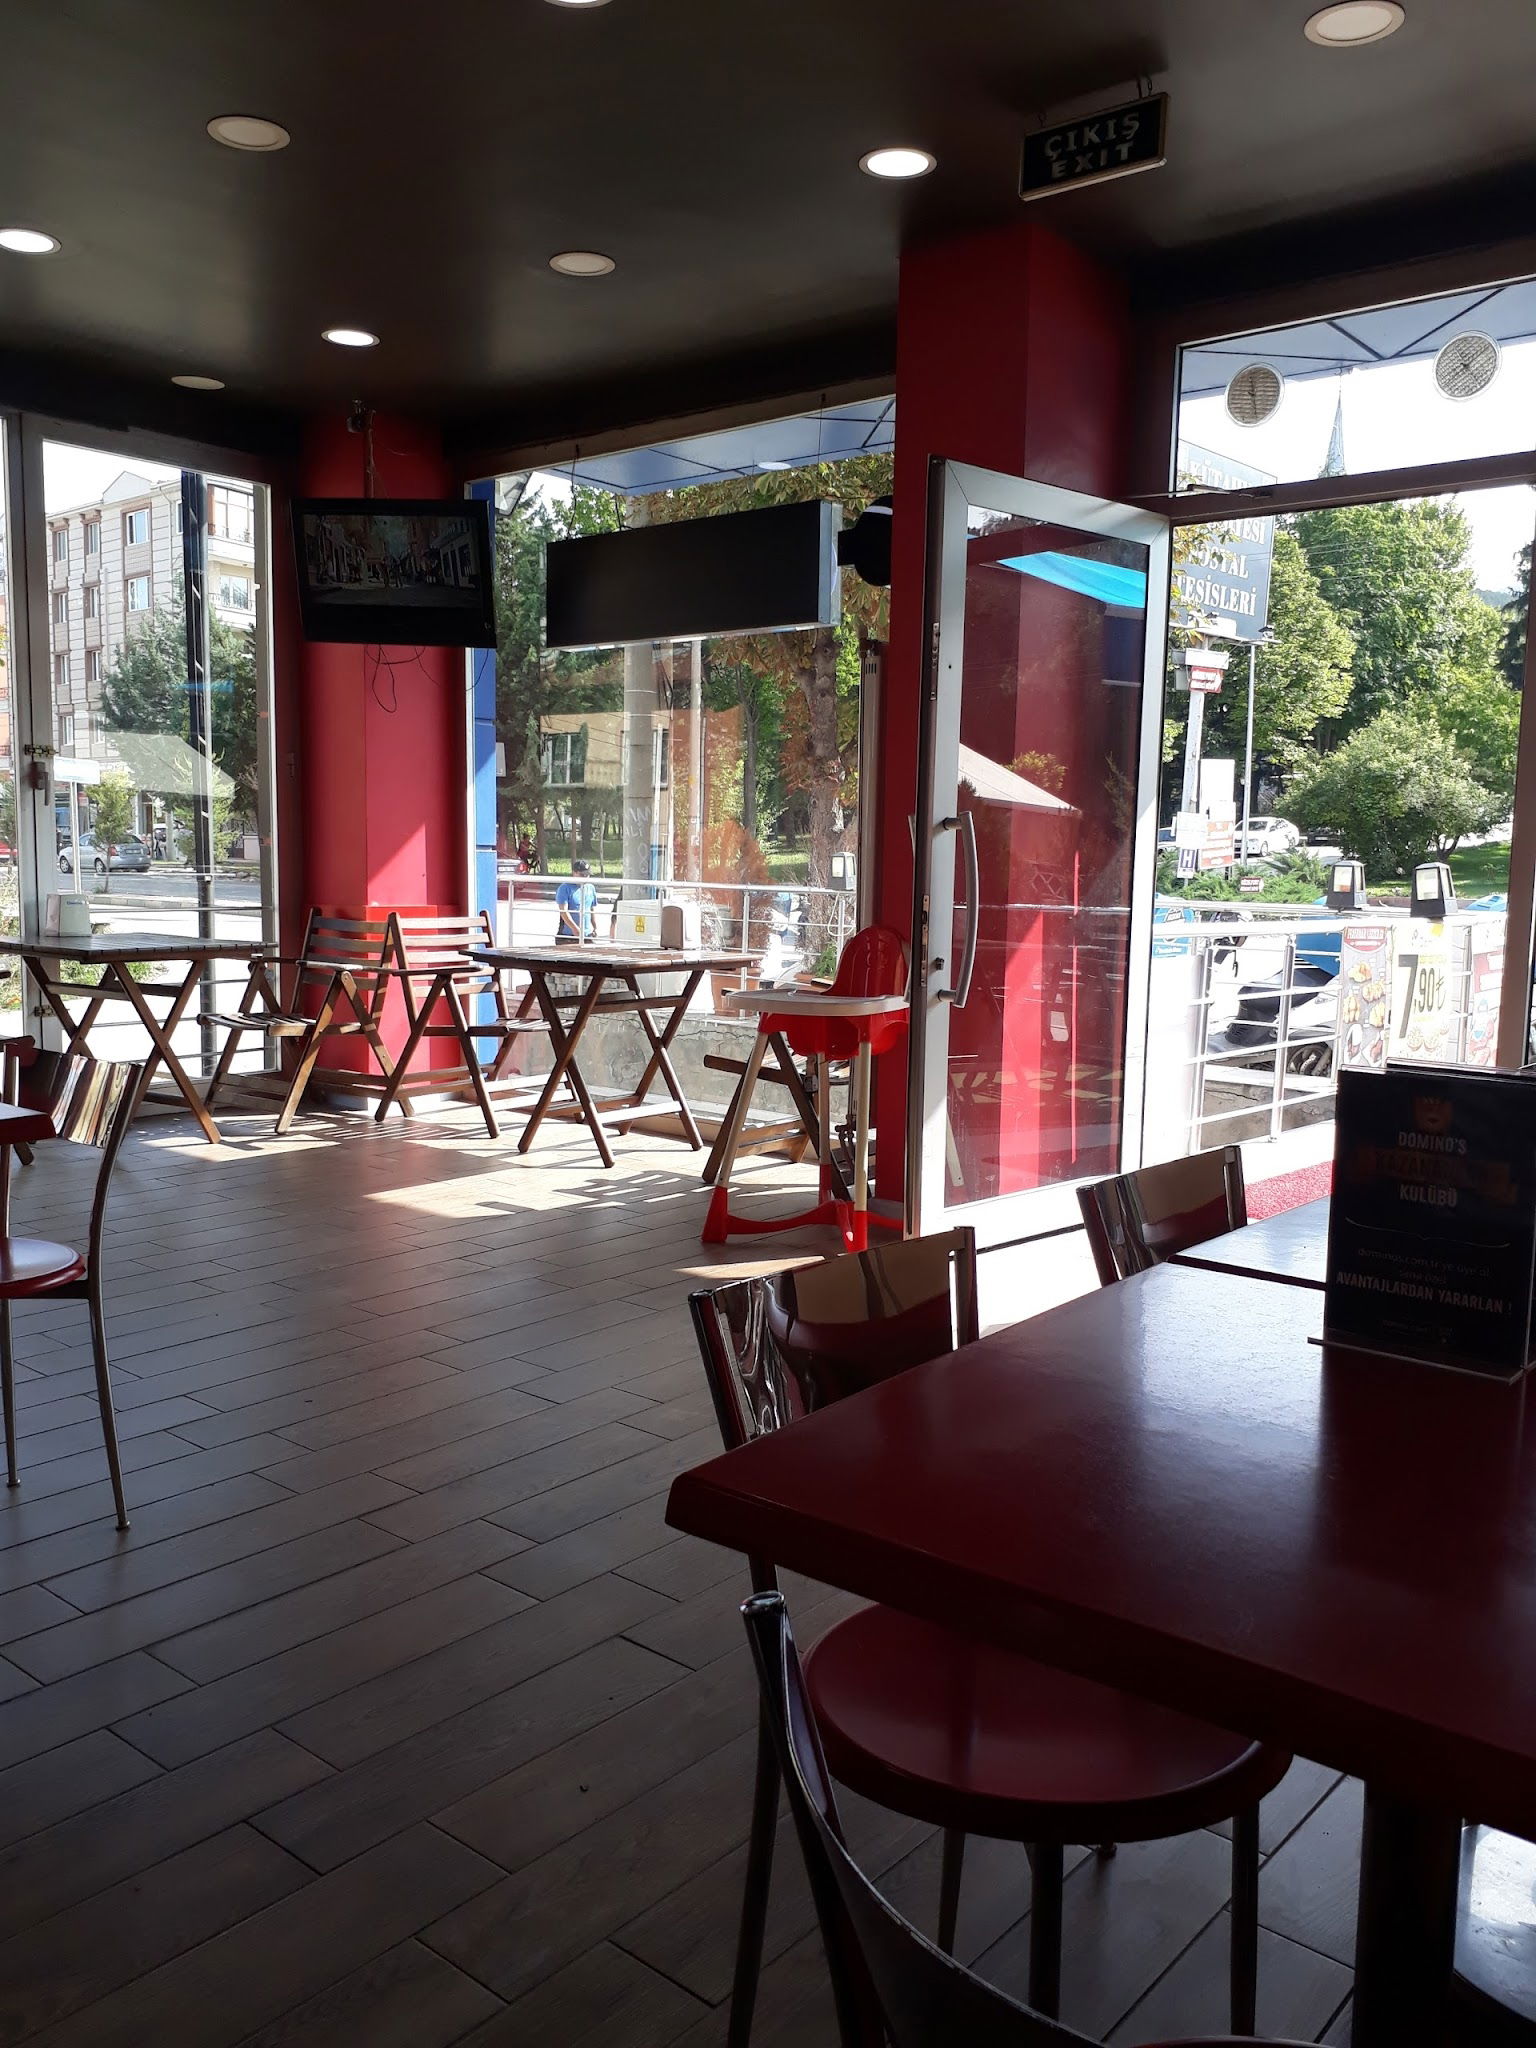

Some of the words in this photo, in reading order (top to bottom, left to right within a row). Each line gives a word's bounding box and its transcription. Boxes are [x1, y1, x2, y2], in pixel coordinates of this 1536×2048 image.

[1044, 112, 1140, 160] ÇIKIŞ
[1051, 141, 1134, 179] EXIT
[1174, 574, 1257, 617] TESİSLERİ
[1182, 849, 1194, 869] H
[1398, 1131, 1468, 1155] DOMINO'S
[1335, 1271, 1433, 1301] AVANTAJLARDAN
[1437, 1288, 1504, 1314] YARARLAN
